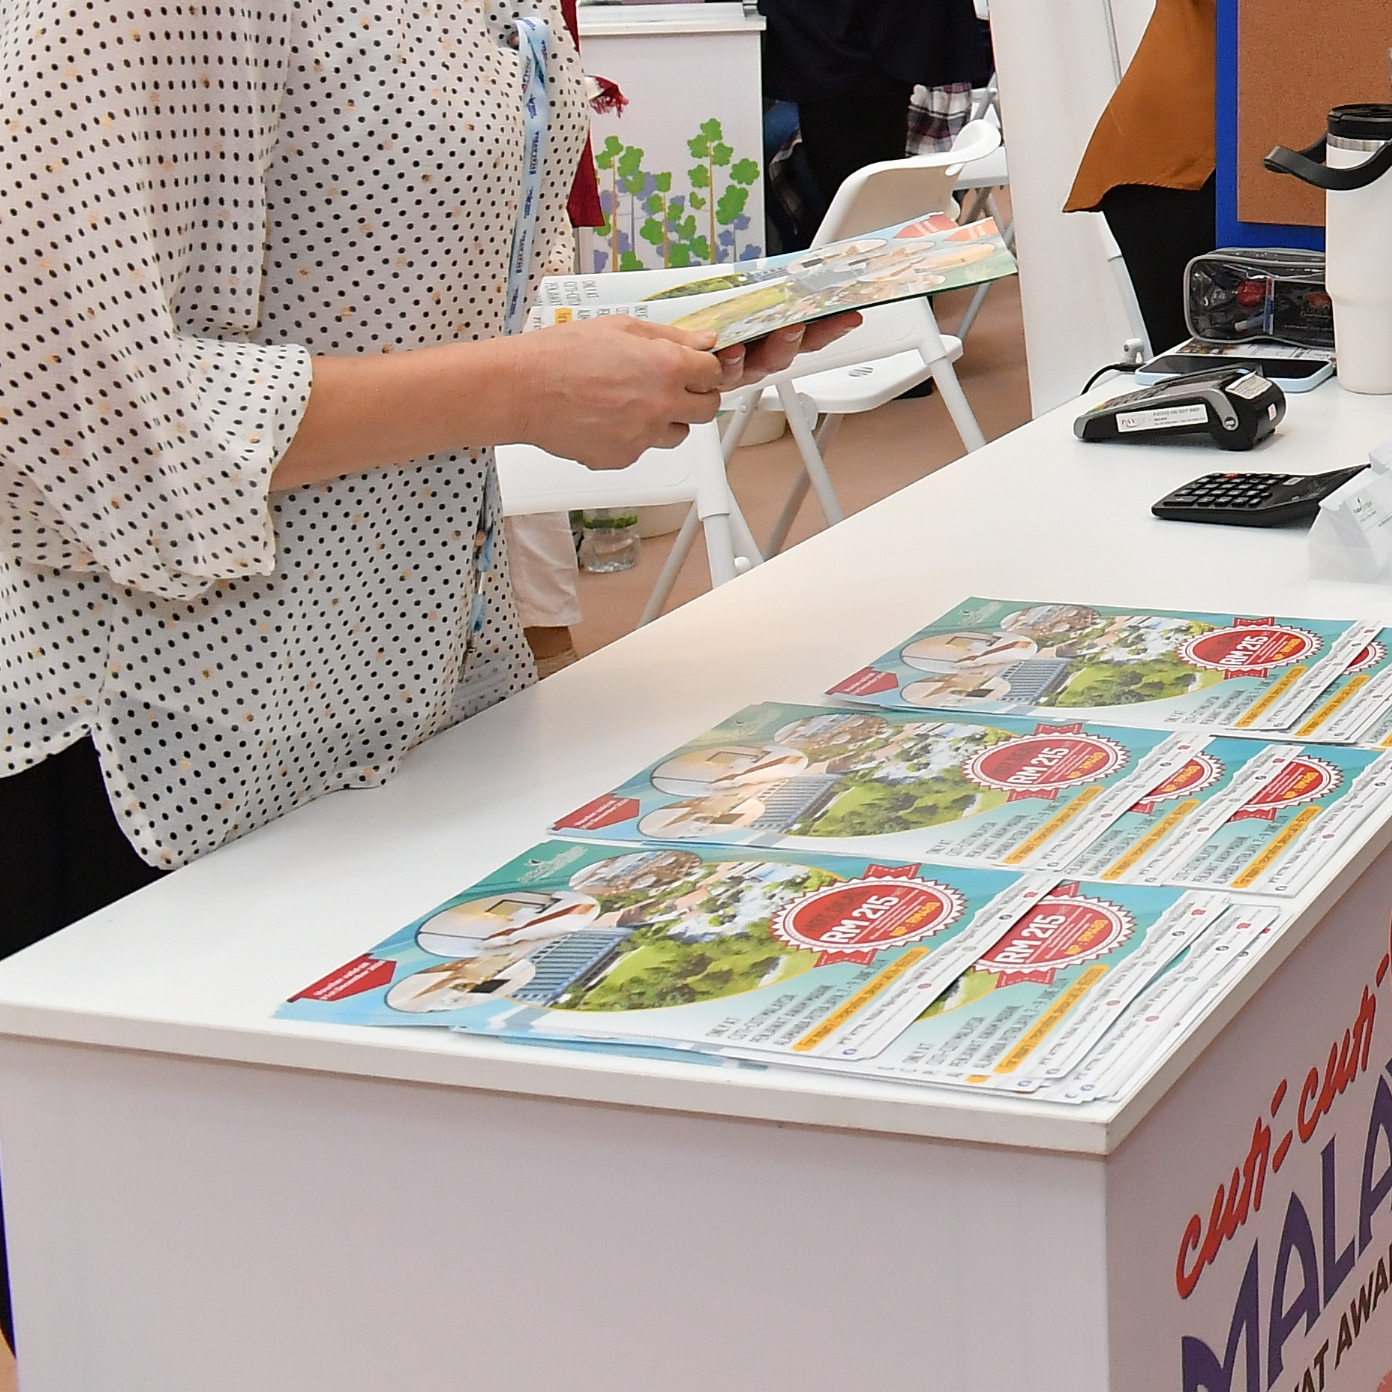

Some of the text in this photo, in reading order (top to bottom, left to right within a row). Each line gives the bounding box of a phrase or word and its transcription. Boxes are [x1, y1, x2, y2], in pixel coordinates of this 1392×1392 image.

[1219, 635, 1269, 666] RM 215
[1006, 747, 1070, 785] RM 215
[819, 895, 900, 944] RM 215
[994, 914, 1066, 963] RM 215
